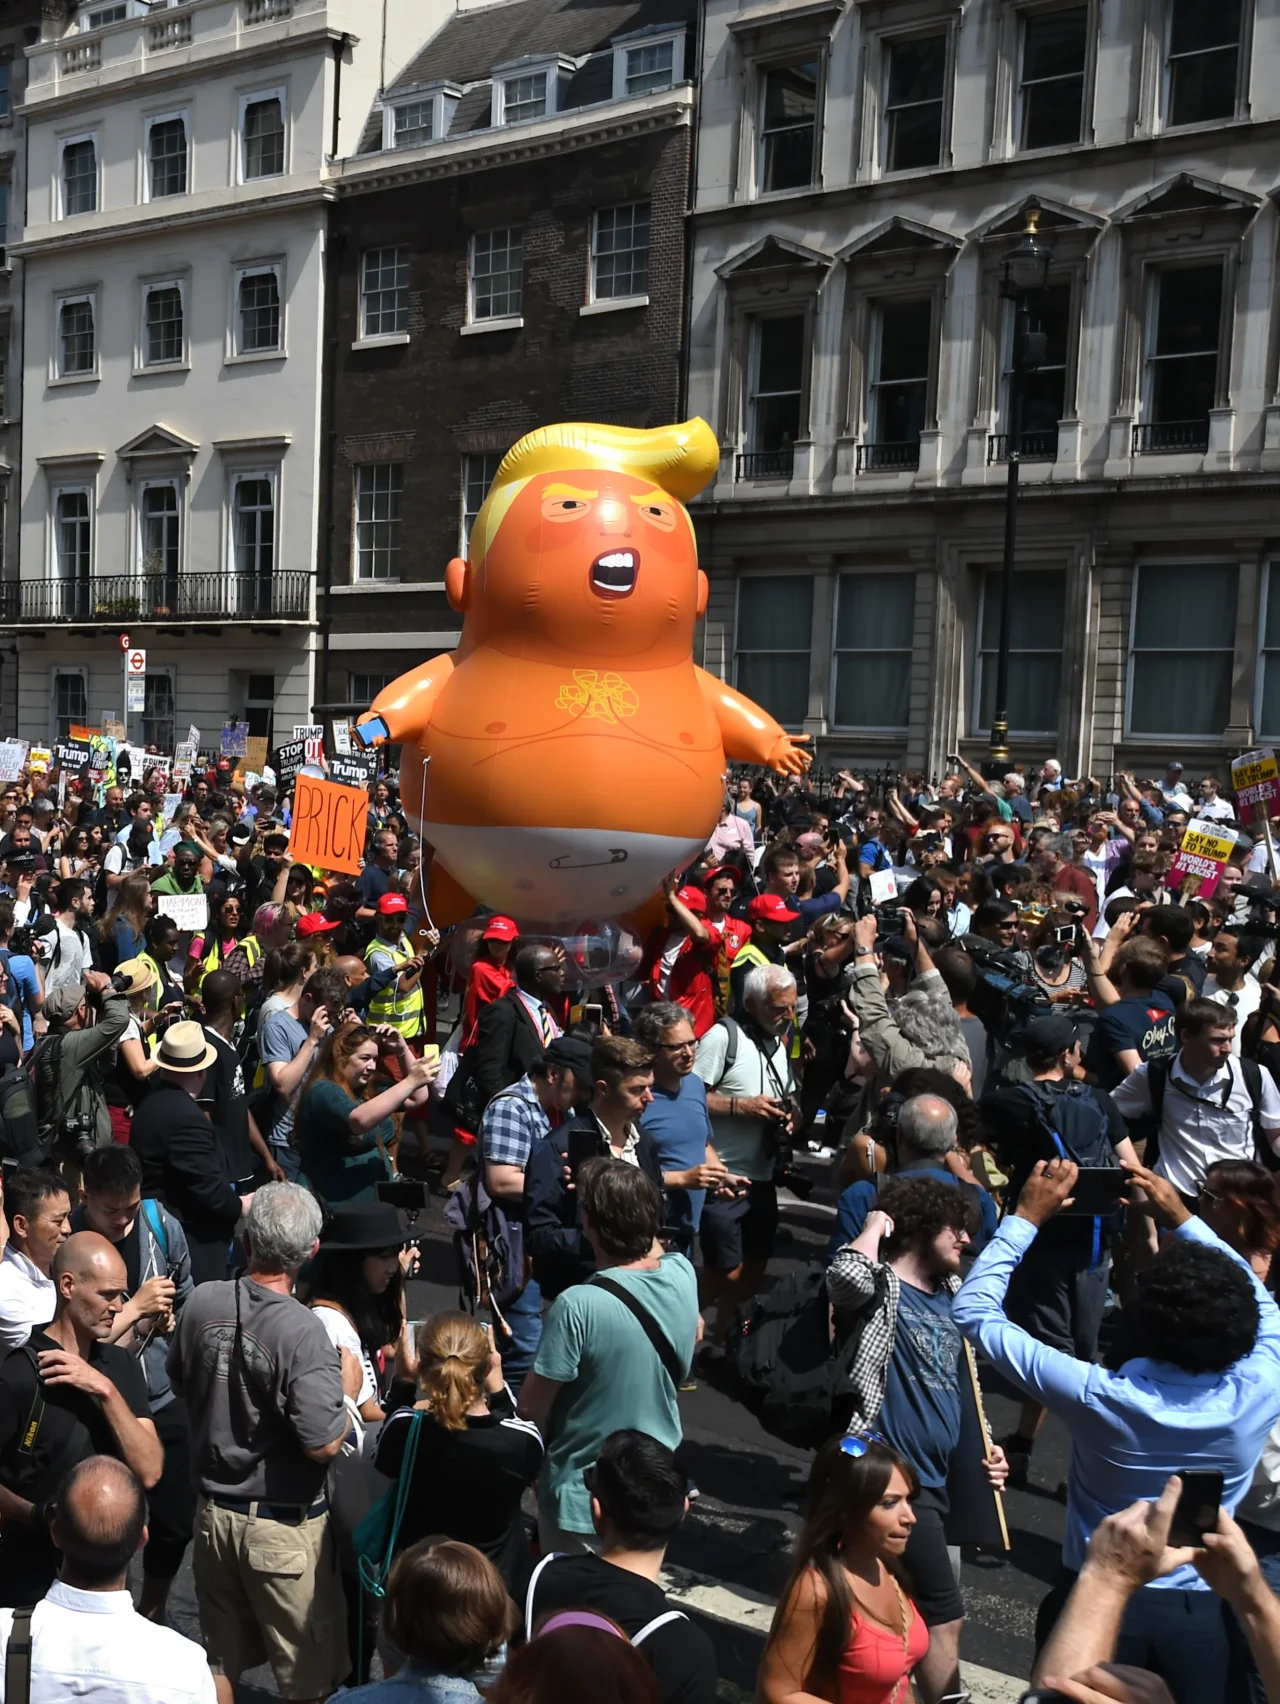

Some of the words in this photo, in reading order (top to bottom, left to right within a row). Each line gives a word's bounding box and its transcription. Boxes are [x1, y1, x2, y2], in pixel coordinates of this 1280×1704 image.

[122, 636, 129, 648] G
[294, 727, 322, 740] TRUMP
[57, 745, 89, 764] Trump
[280, 741, 303, 759] STOP
[304, 739, 321, 758] OT
[142, 757, 168, 766] #DUMP
[331, 760, 368, 782] Trump
[1233, 768, 1248, 778] SAY
[1250, 764, 1262, 774] NO
[1236, 777, 1245, 787] TO
[1247, 769, 1275, 783] TRUMP
[1237, 781, 1272, 798] WORLD'S
[1249, 788, 1277, 804] RACIST
[294, 784, 366, 862] PRICK
[1187, 833, 1204, 843] SAY
[1205, 837, 1219, 848] NO
[1185, 841, 1196, 851] TO
[1199, 845, 1228, 859] TRUMP
[1180, 852, 1217, 870] WORLD'S
[1175, 861, 1186, 871] #1
[1187, 863, 1219, 880] RACIST
[24, 1420, 38, 1447] Nikon
